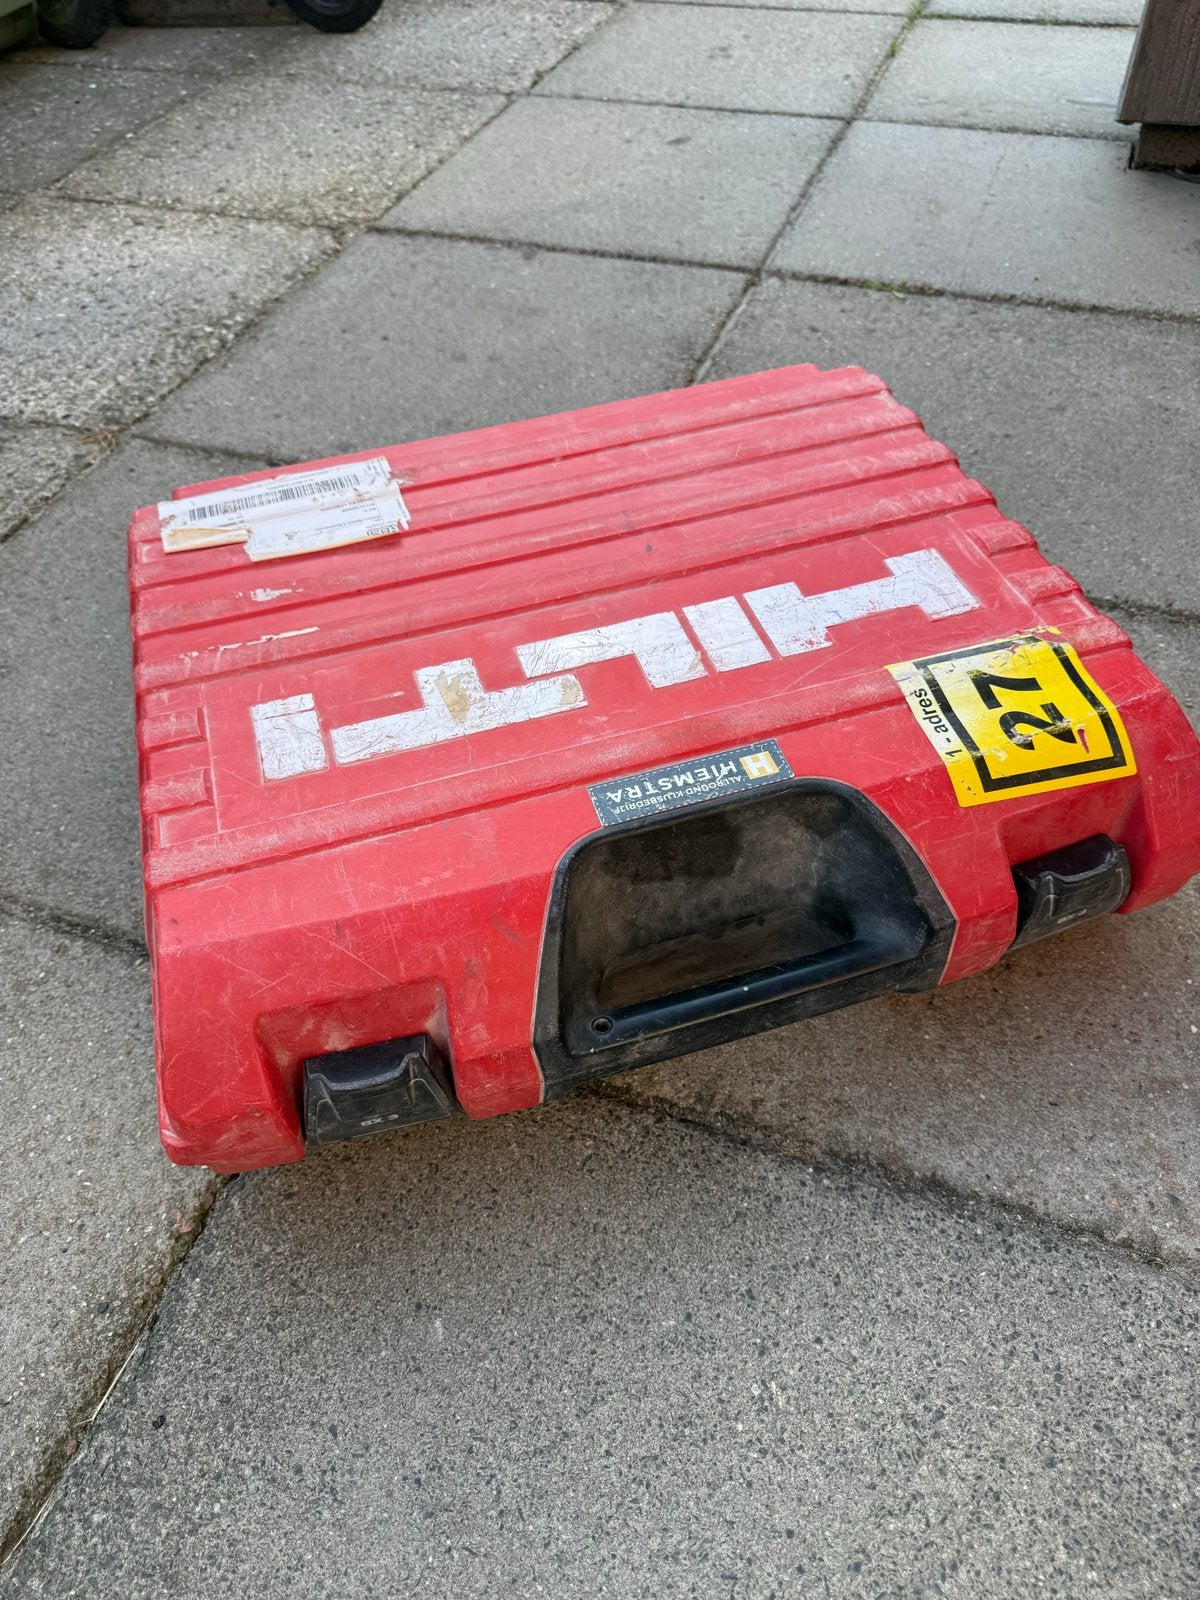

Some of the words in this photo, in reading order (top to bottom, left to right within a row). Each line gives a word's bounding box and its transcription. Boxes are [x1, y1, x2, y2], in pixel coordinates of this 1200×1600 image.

[251, 548, 981, 781] HILTI
[913, 687, 949, 734] adres
[968, 668, 1077, 751] 27
[945, 748, 963, 758] 1
[605, 760, 738, 803] HIEMSTRA
[614, 790, 684, 814] KLUSBEDRIJF
